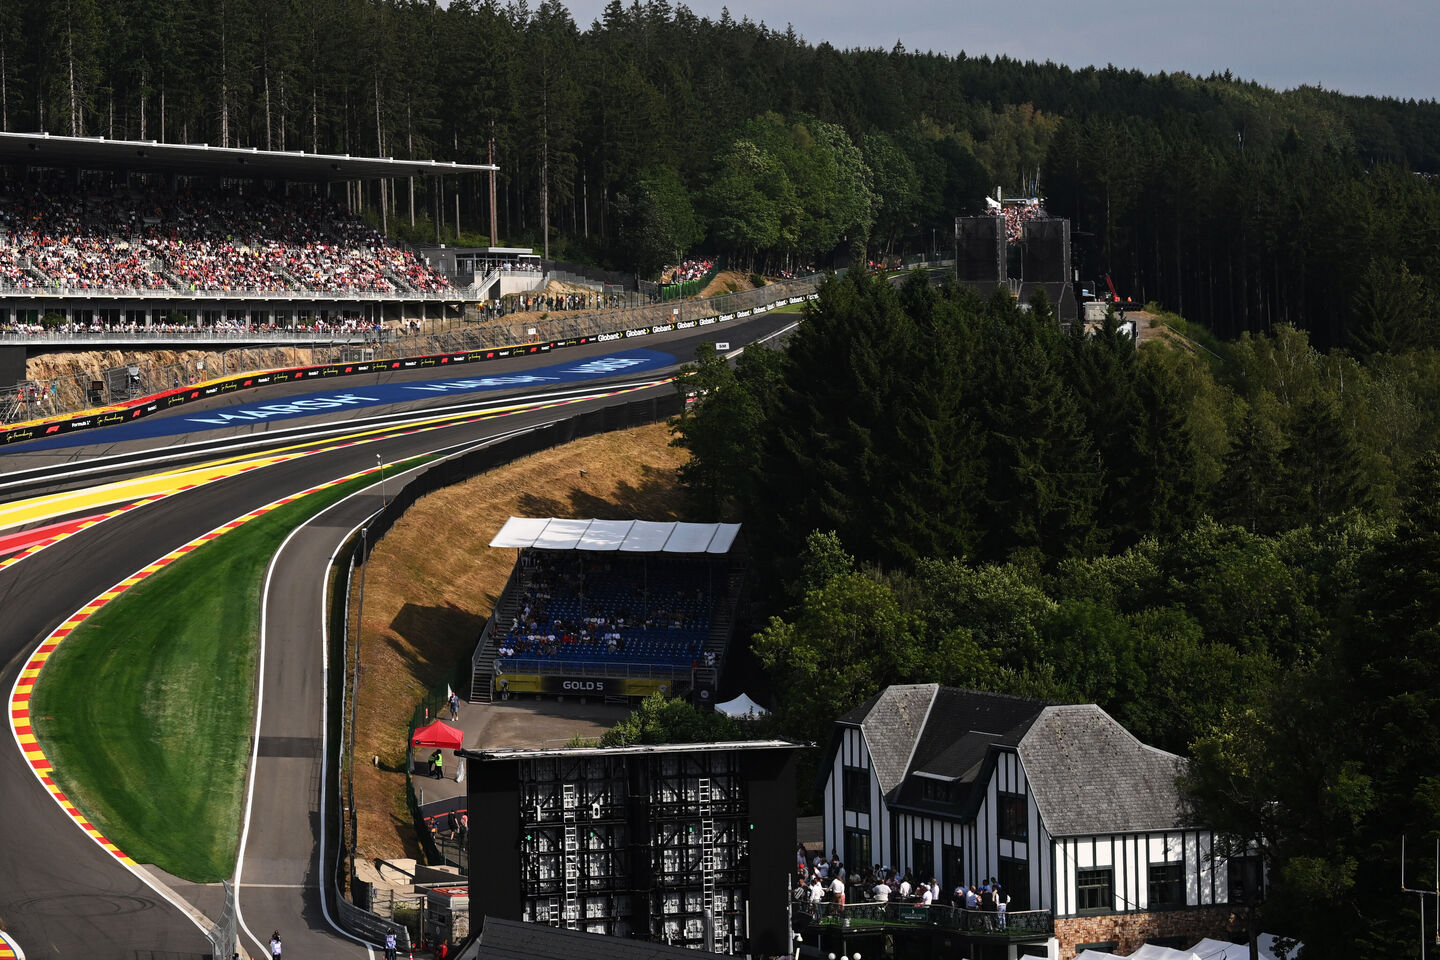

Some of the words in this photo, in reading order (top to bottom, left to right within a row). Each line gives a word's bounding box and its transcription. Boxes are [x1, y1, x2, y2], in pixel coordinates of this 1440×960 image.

[652, 324, 672, 334] Globant
[677, 321, 695, 330] Globant
[598, 333, 620, 342] Globant
[626, 328, 647, 338] Globant
[184, 394, 380, 424] MARSH
[562, 680, 594, 690] GOLD
[596, 682, 604, 690] 5
